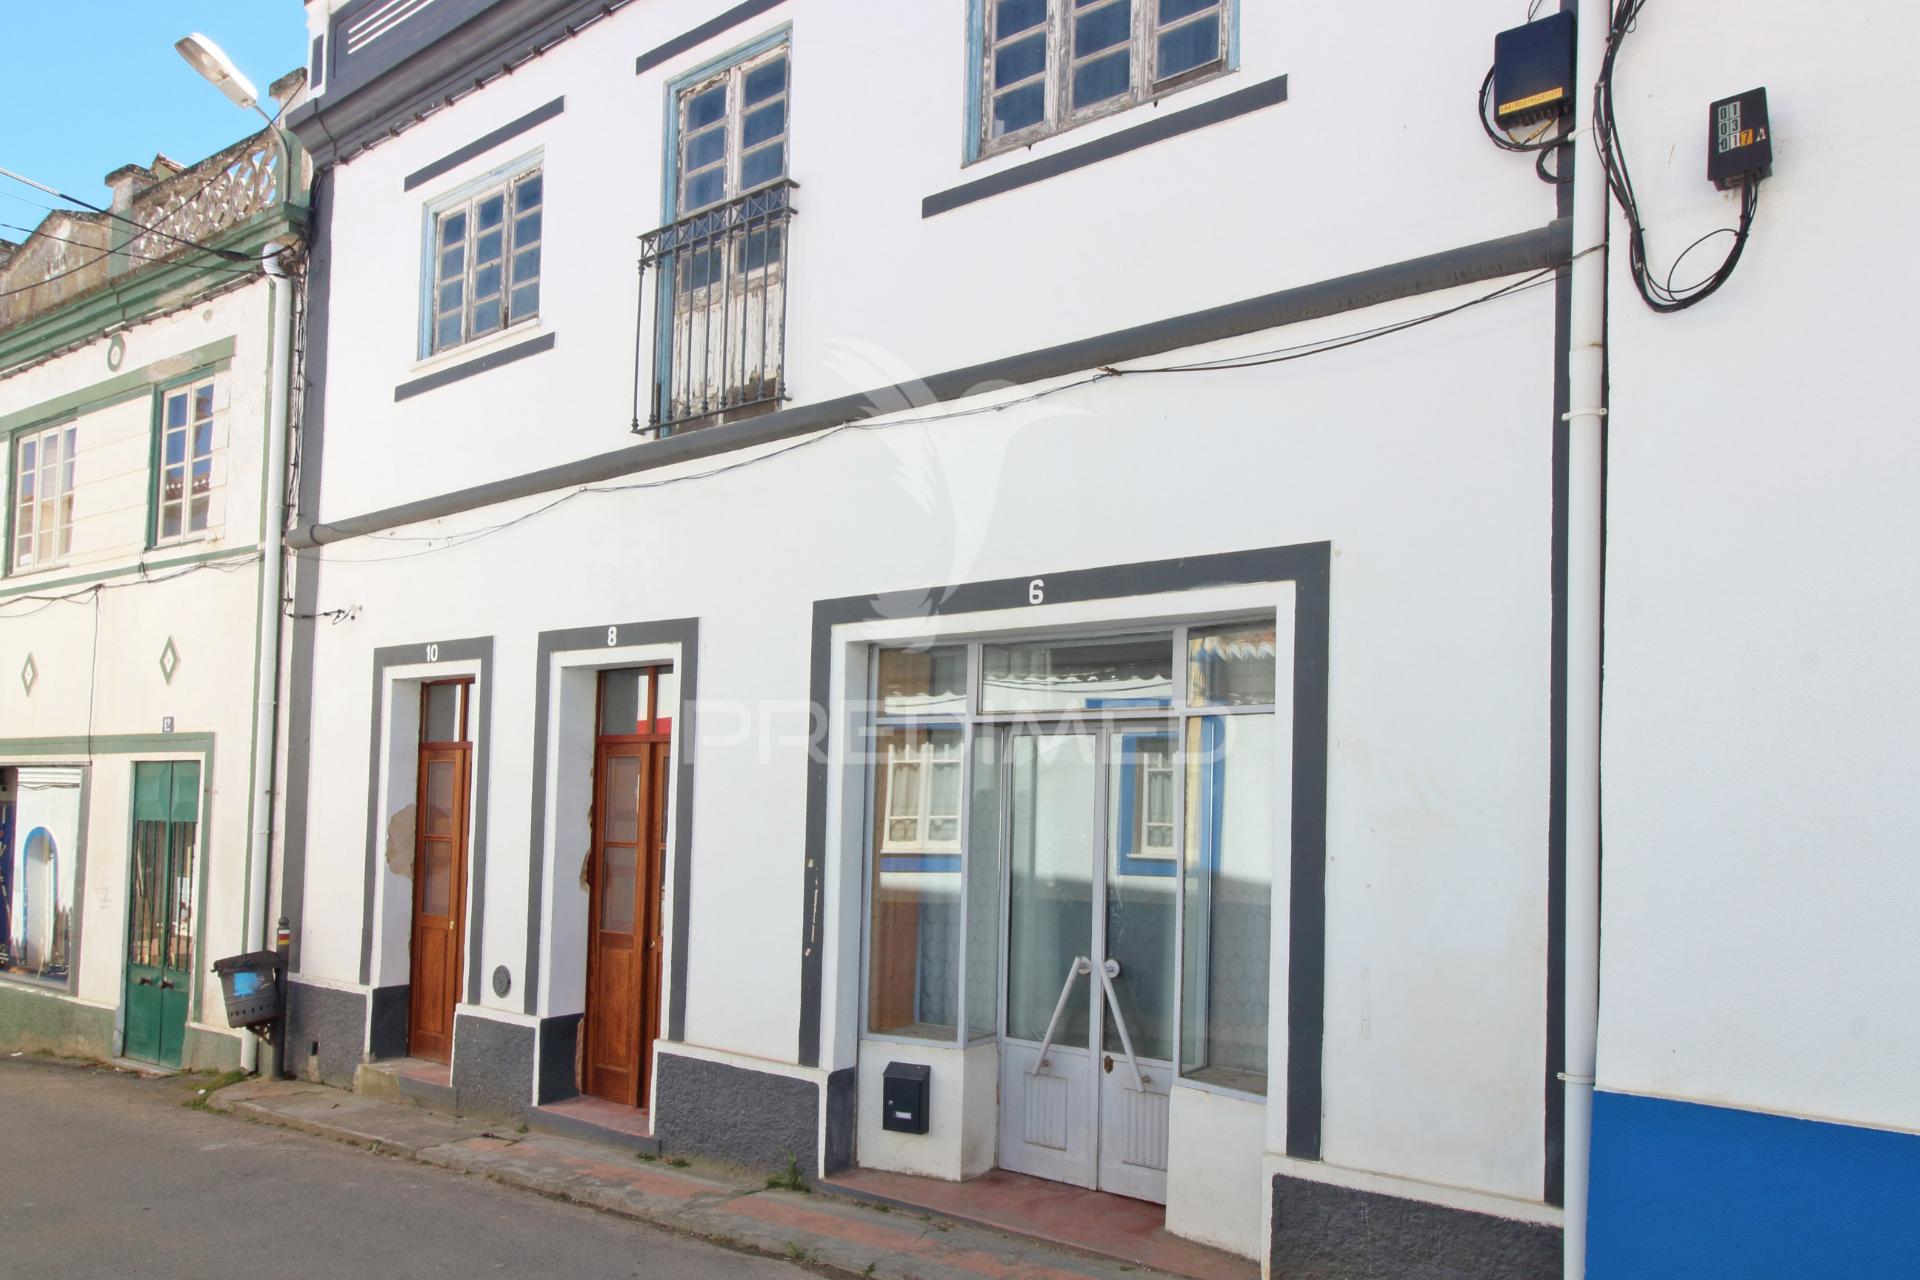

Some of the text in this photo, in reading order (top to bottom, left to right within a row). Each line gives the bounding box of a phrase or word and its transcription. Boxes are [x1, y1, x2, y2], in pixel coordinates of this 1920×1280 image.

[1029, 579, 1044, 605] 6
[608, 626, 617, 646] 8
[426, 644, 438, 662] 10
